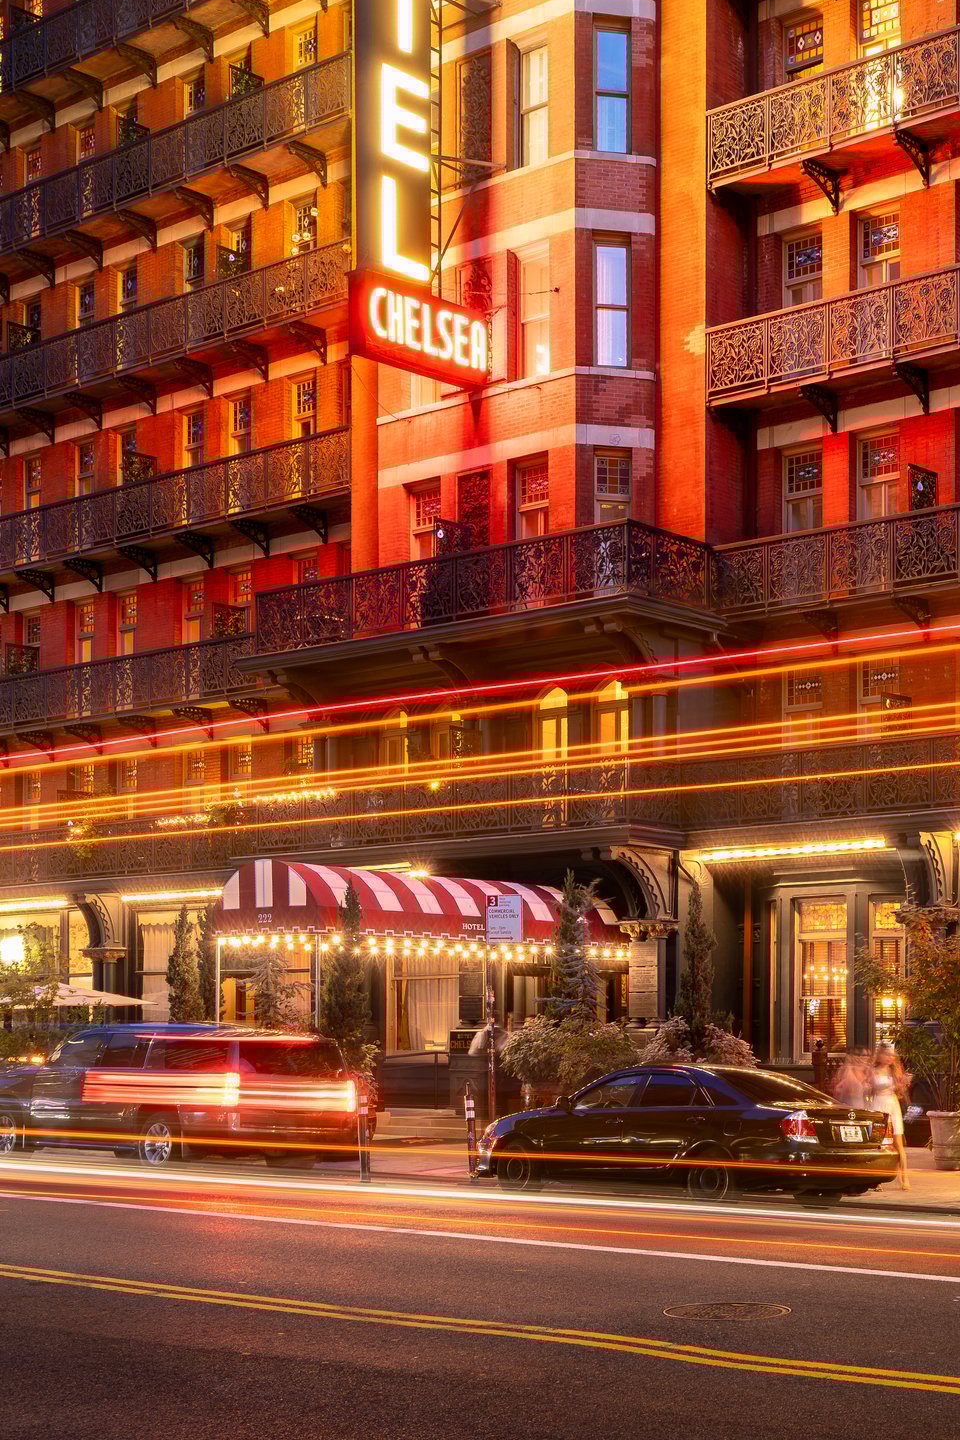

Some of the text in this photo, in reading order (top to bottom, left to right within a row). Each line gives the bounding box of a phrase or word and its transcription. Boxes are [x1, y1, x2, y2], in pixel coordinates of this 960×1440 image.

[369, 287, 487, 372] CHELSEA
[489, 896, 496, 906] 3
[258, 913, 272, 923] 222
[462, 922, 486, 931] HOTEL
[450, 1040, 472, 1049] CHELS
